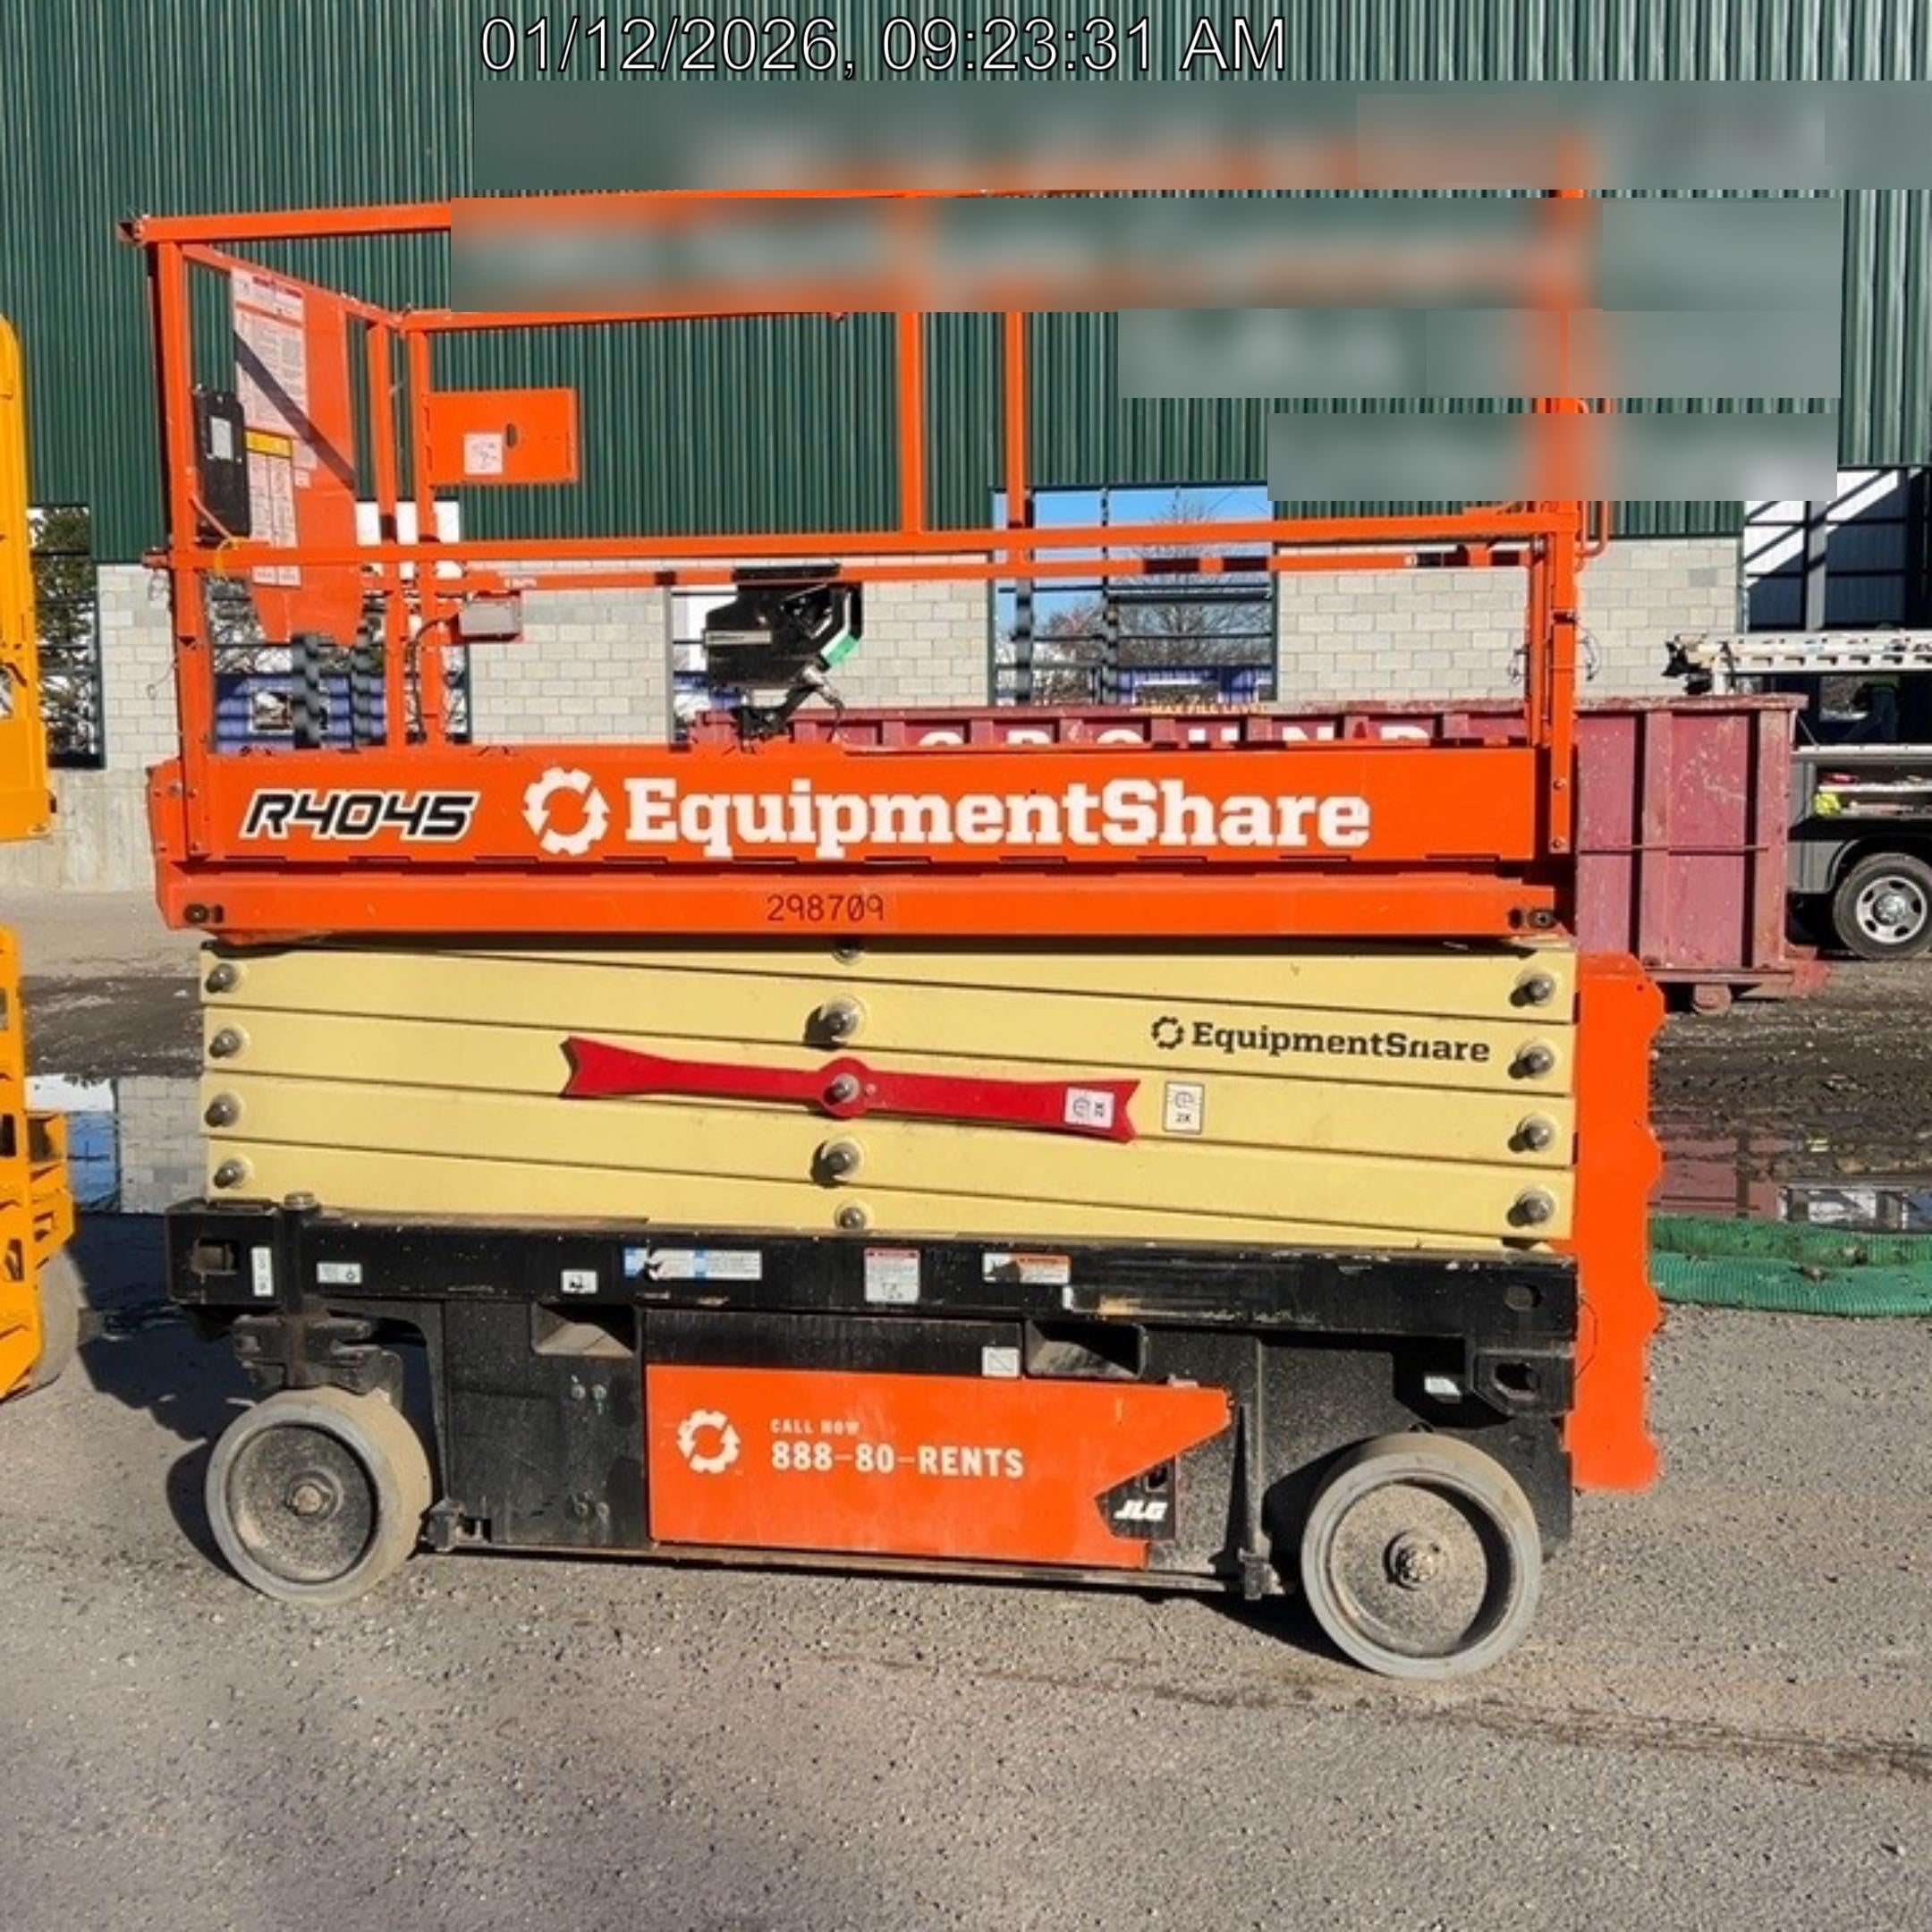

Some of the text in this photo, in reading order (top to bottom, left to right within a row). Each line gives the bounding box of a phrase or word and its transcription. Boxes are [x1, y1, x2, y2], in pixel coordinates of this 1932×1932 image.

[239, 788, 481, 842] R4045
[623, 776, 1371, 860] EquipmentShare
[767, 893, 884, 921] 298709
[769, 1418, 860, 1436] CALL NOW
[771, 1439, 1025, 1479] 888-80-RENTS
[1114, 1499, 1168, 1521] JLG
